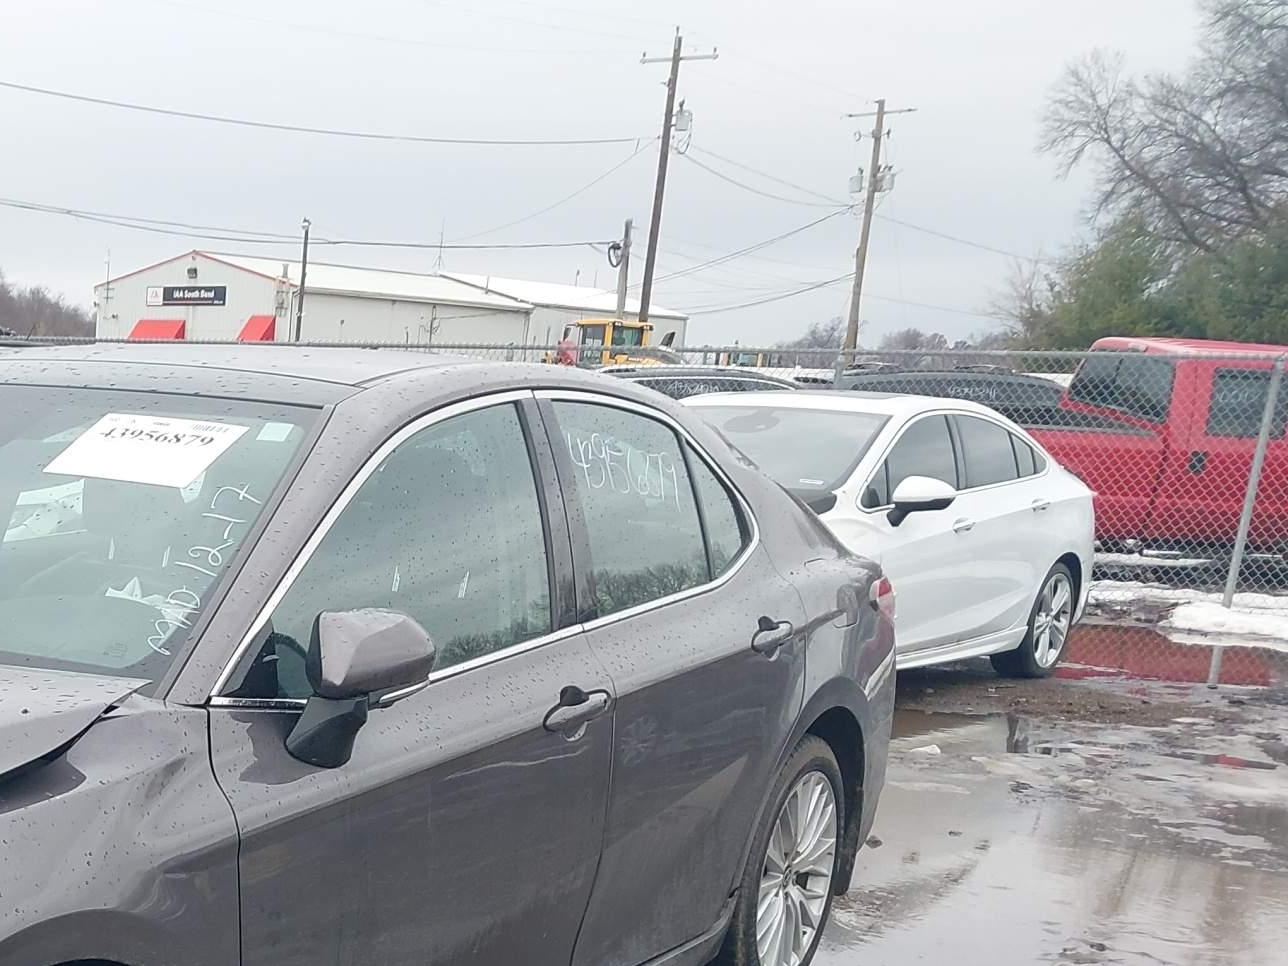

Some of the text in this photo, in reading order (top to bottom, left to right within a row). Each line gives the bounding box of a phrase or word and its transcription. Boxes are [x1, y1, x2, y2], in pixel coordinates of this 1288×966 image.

[184, 289, 200, 299] South
[99, 427, 215, 447] 43956879
[173, 483, 263, 577] 12-17
